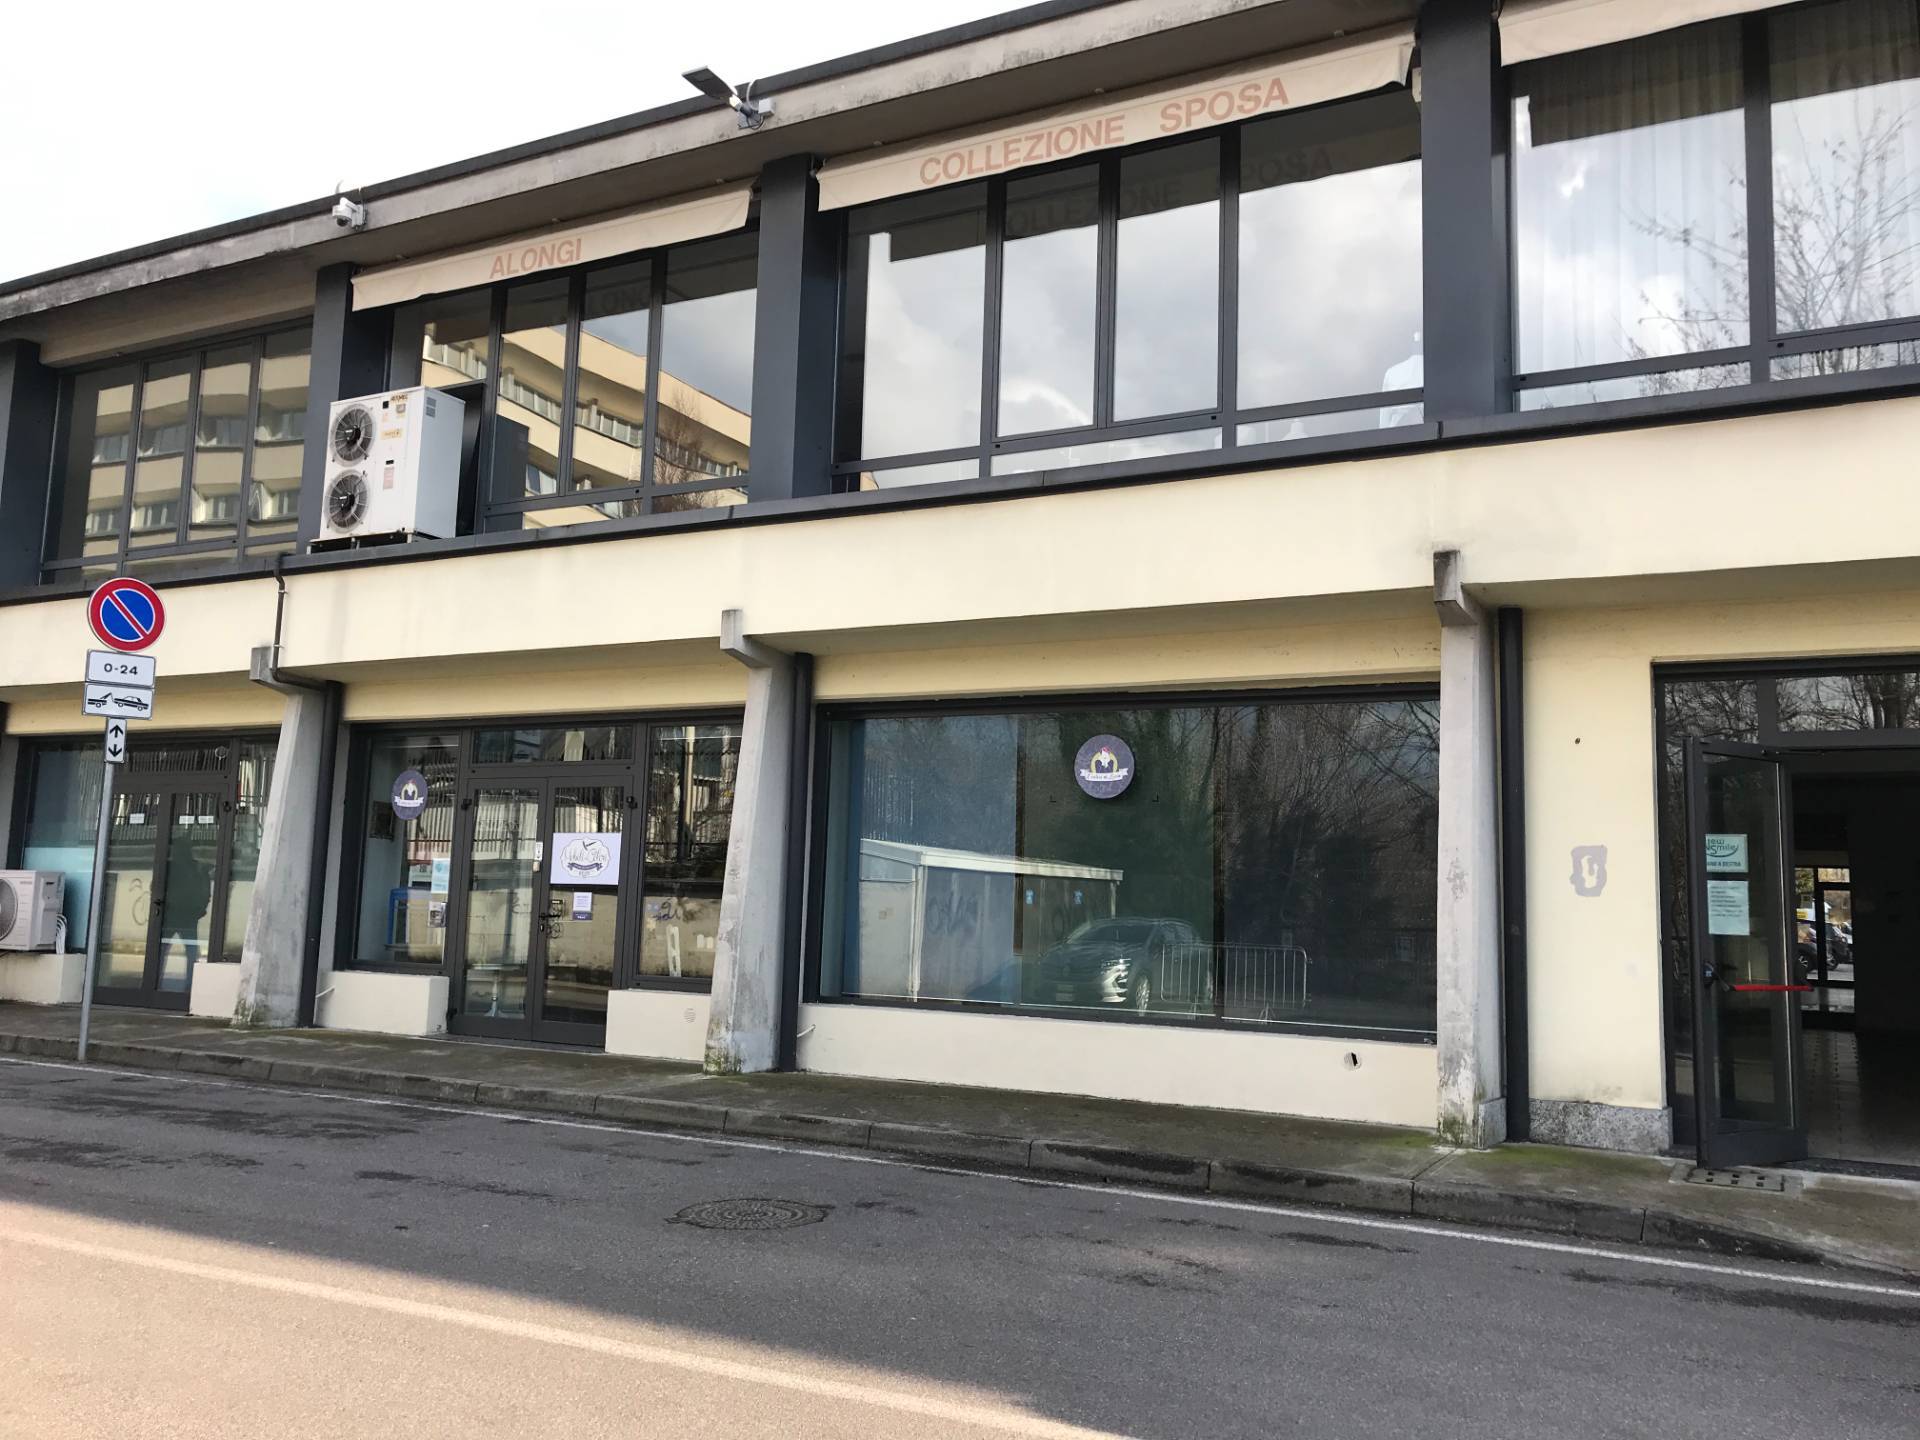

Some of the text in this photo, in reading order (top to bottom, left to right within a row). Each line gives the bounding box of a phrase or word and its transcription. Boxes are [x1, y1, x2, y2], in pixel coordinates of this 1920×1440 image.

[920, 78, 1289, 186] COLLEZIONE SPOSA
[489, 238, 582, 279] ALONGI
[1710, 843, 1736, 855] Smile
